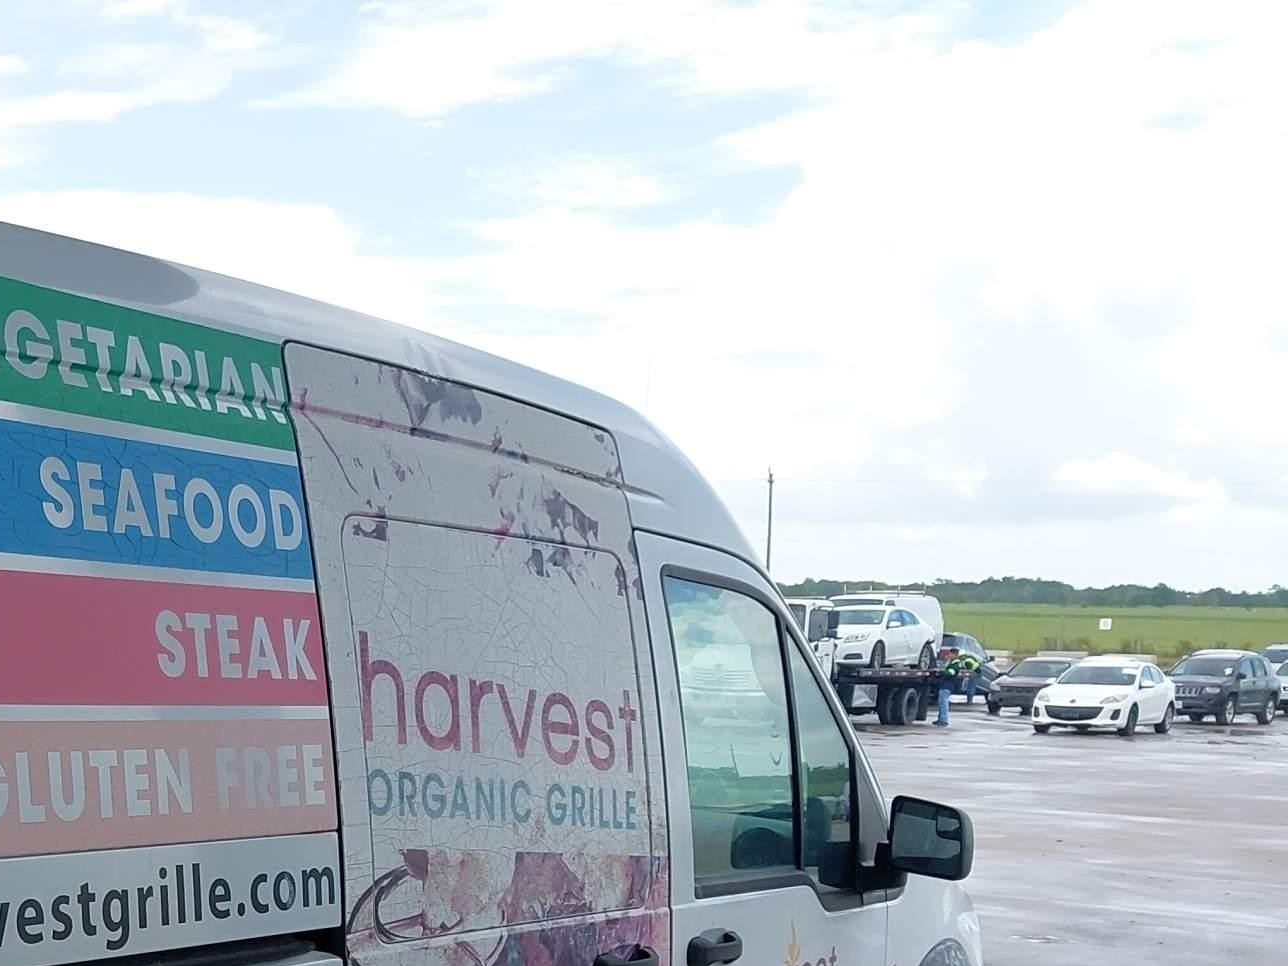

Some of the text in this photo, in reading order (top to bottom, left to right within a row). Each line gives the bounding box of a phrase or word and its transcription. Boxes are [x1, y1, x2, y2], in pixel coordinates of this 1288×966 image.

[39, 456, 303, 551] SEAFOOD
[155, 609, 317, 681] STEAK
[358, 631, 637, 774] harvest
[215, 743, 326, 811] FREE
[368, 768, 638, 830] ORGANIC GRILLE
